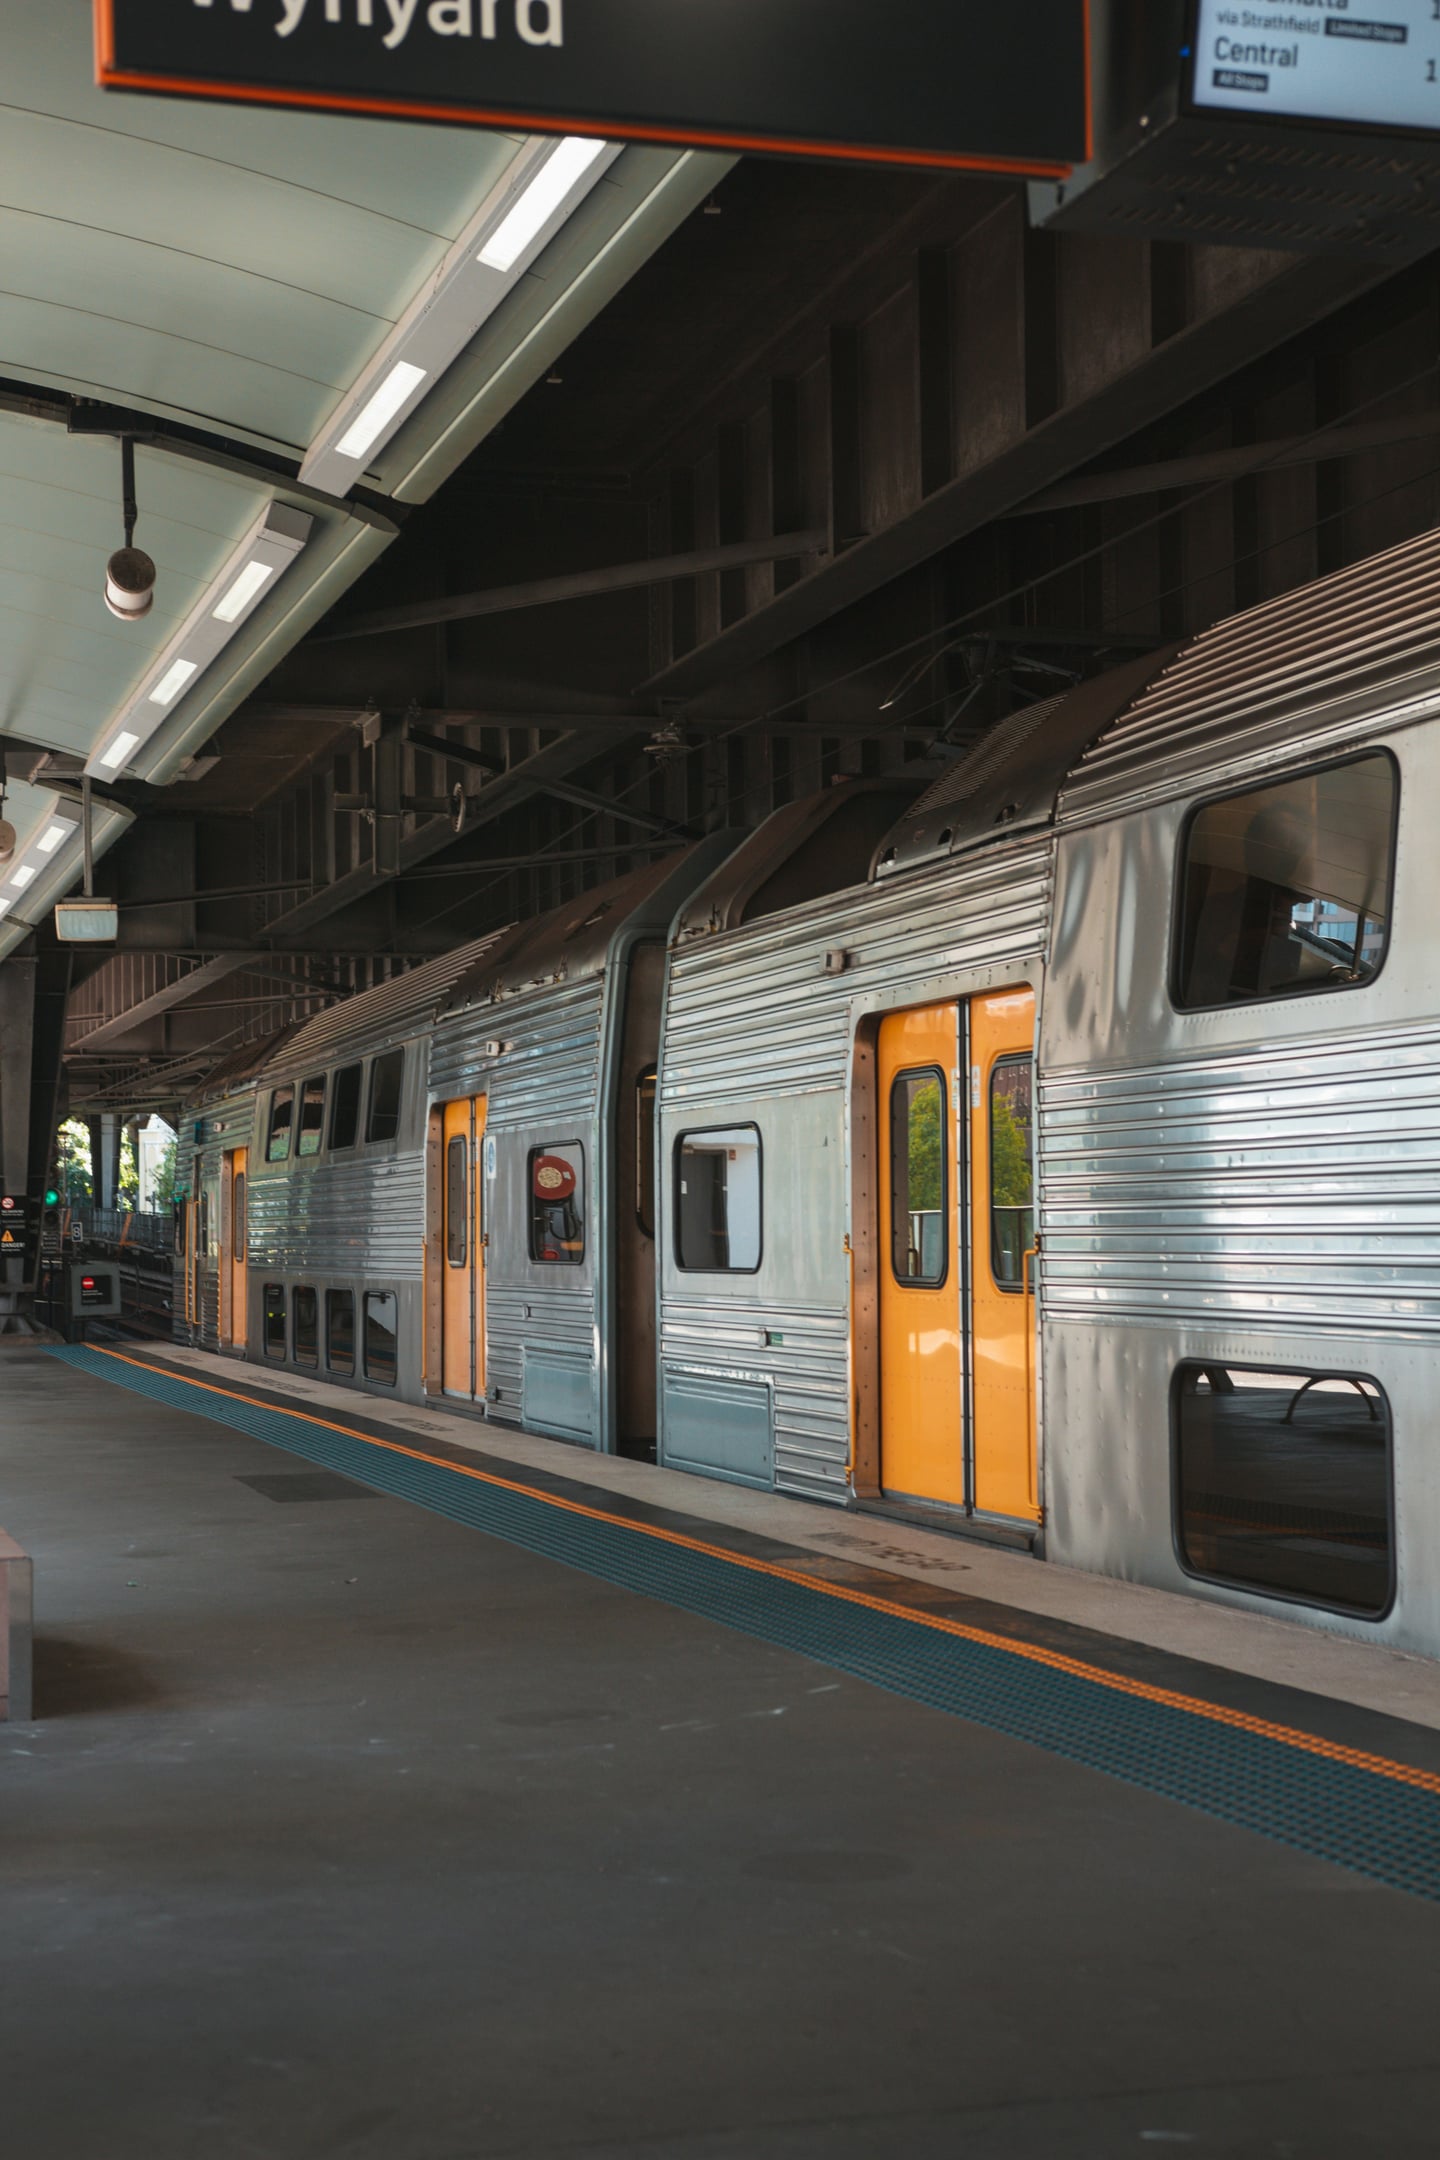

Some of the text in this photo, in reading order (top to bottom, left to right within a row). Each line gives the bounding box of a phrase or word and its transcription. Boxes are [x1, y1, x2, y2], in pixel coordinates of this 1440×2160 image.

[1217, 10, 1238, 26] via
[1241, 10, 1320, 34] Strathfield
[1215, 36, 1299, 67] Central
